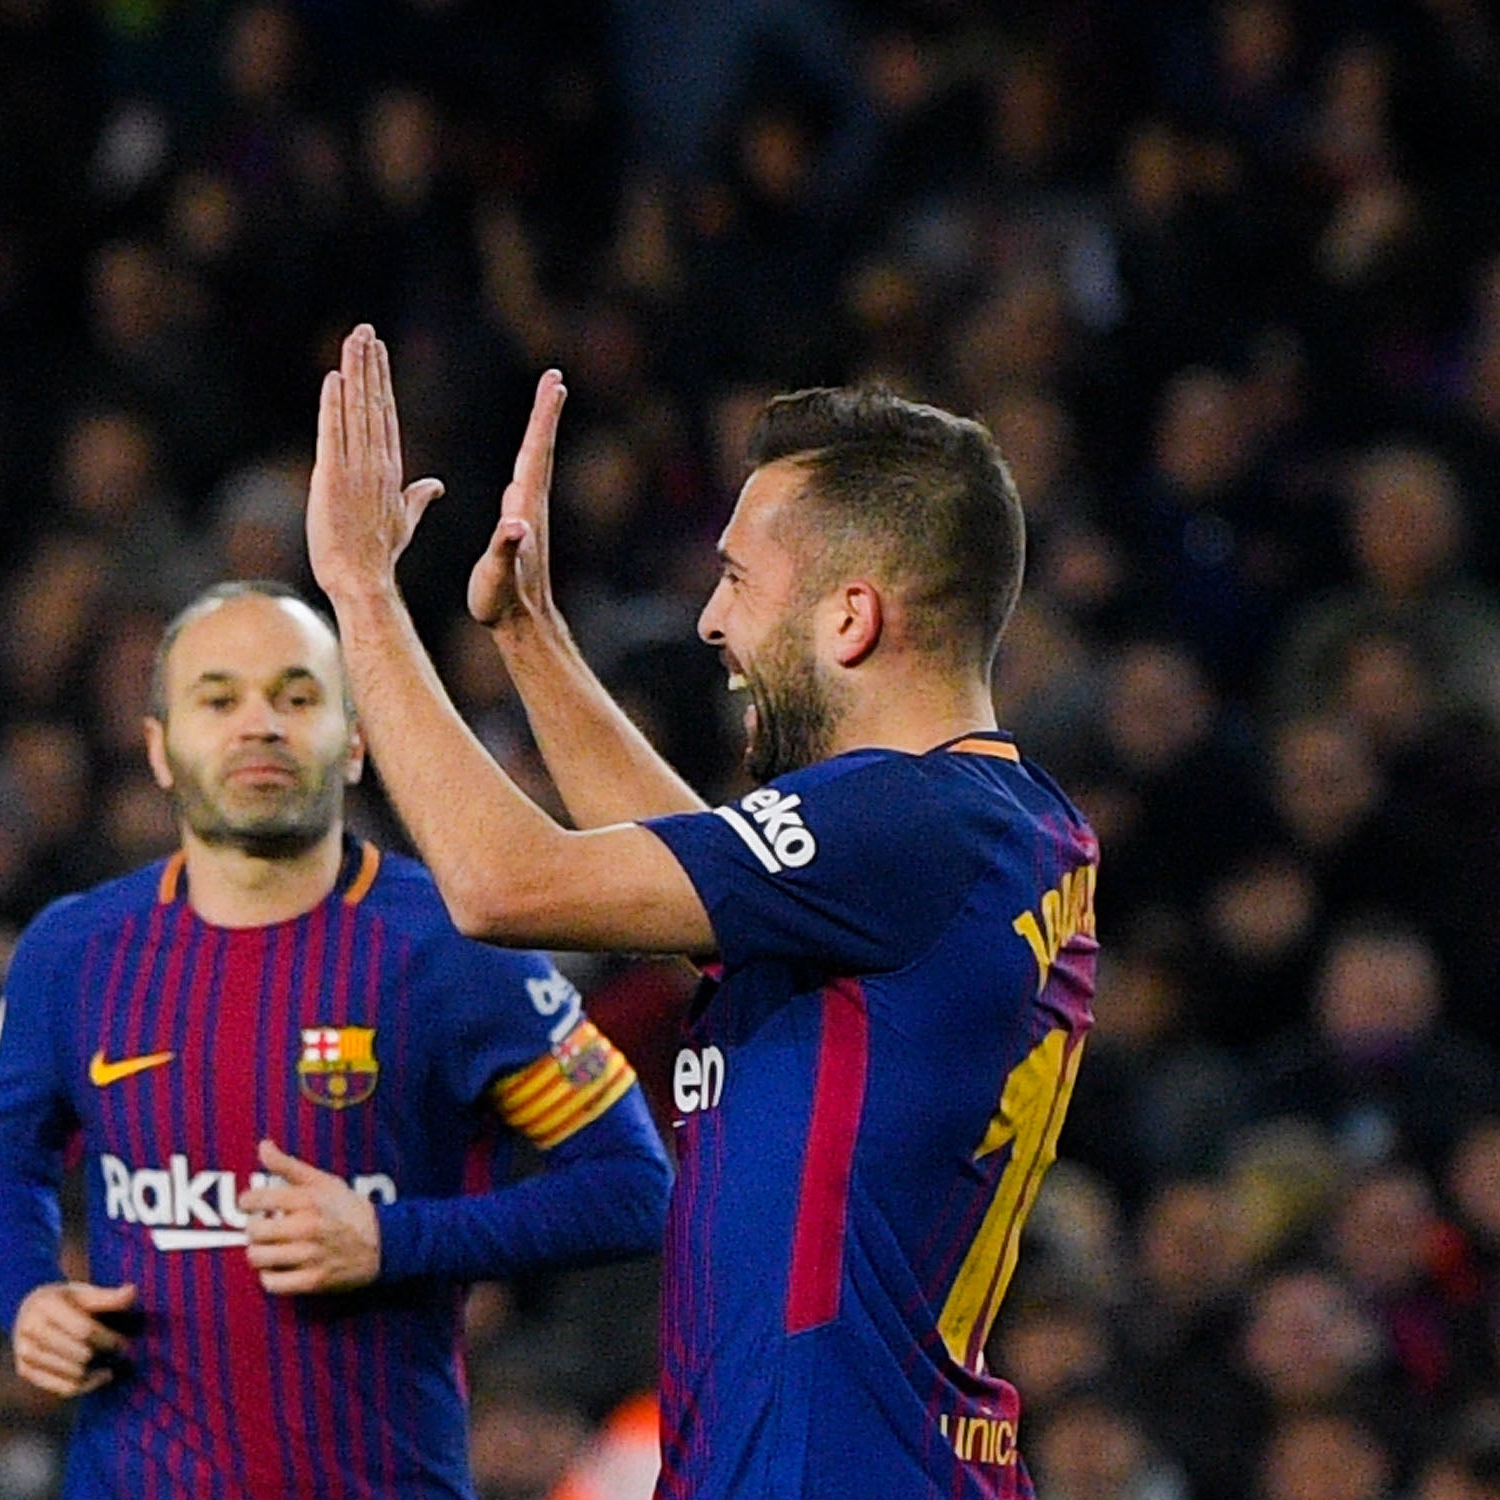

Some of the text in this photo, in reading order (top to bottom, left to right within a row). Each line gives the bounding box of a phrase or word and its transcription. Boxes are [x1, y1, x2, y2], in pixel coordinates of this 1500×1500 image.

[741, 787, 816, 868] eko
[101, 1153, 397, 1228] Rakun
[940, 1413, 1017, 1466] unic
